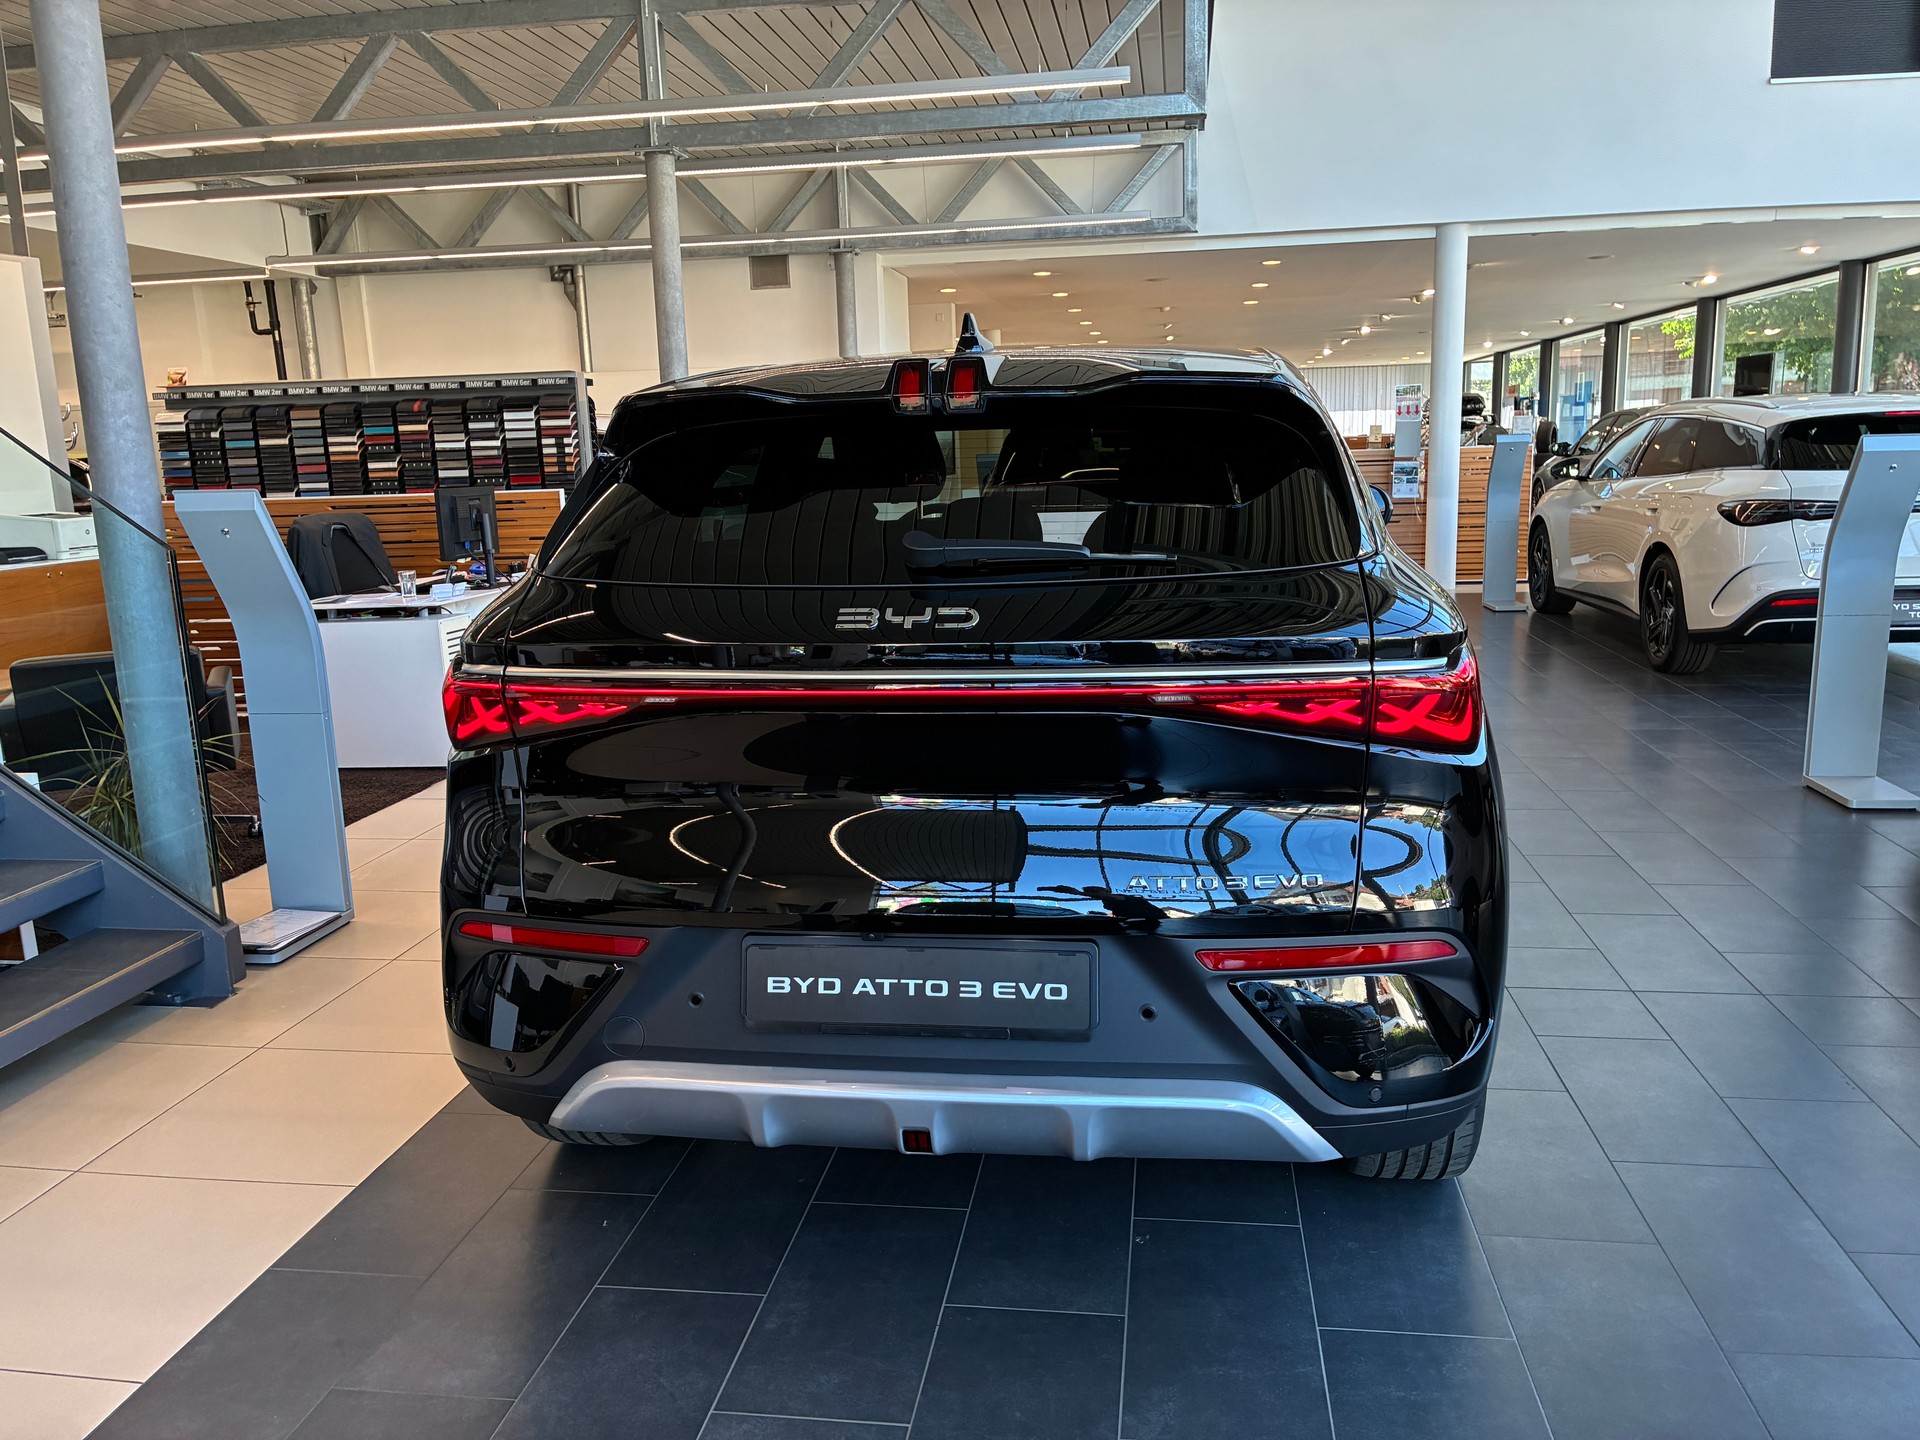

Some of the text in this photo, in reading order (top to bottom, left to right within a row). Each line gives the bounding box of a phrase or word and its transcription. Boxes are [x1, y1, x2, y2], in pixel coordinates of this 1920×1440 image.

[834, 607, 980, 630] BYD
[1127, 874, 1323, 891] ATTO 3 EVO
[767, 977, 1068, 1000] BYD ATTO 3 EVO
